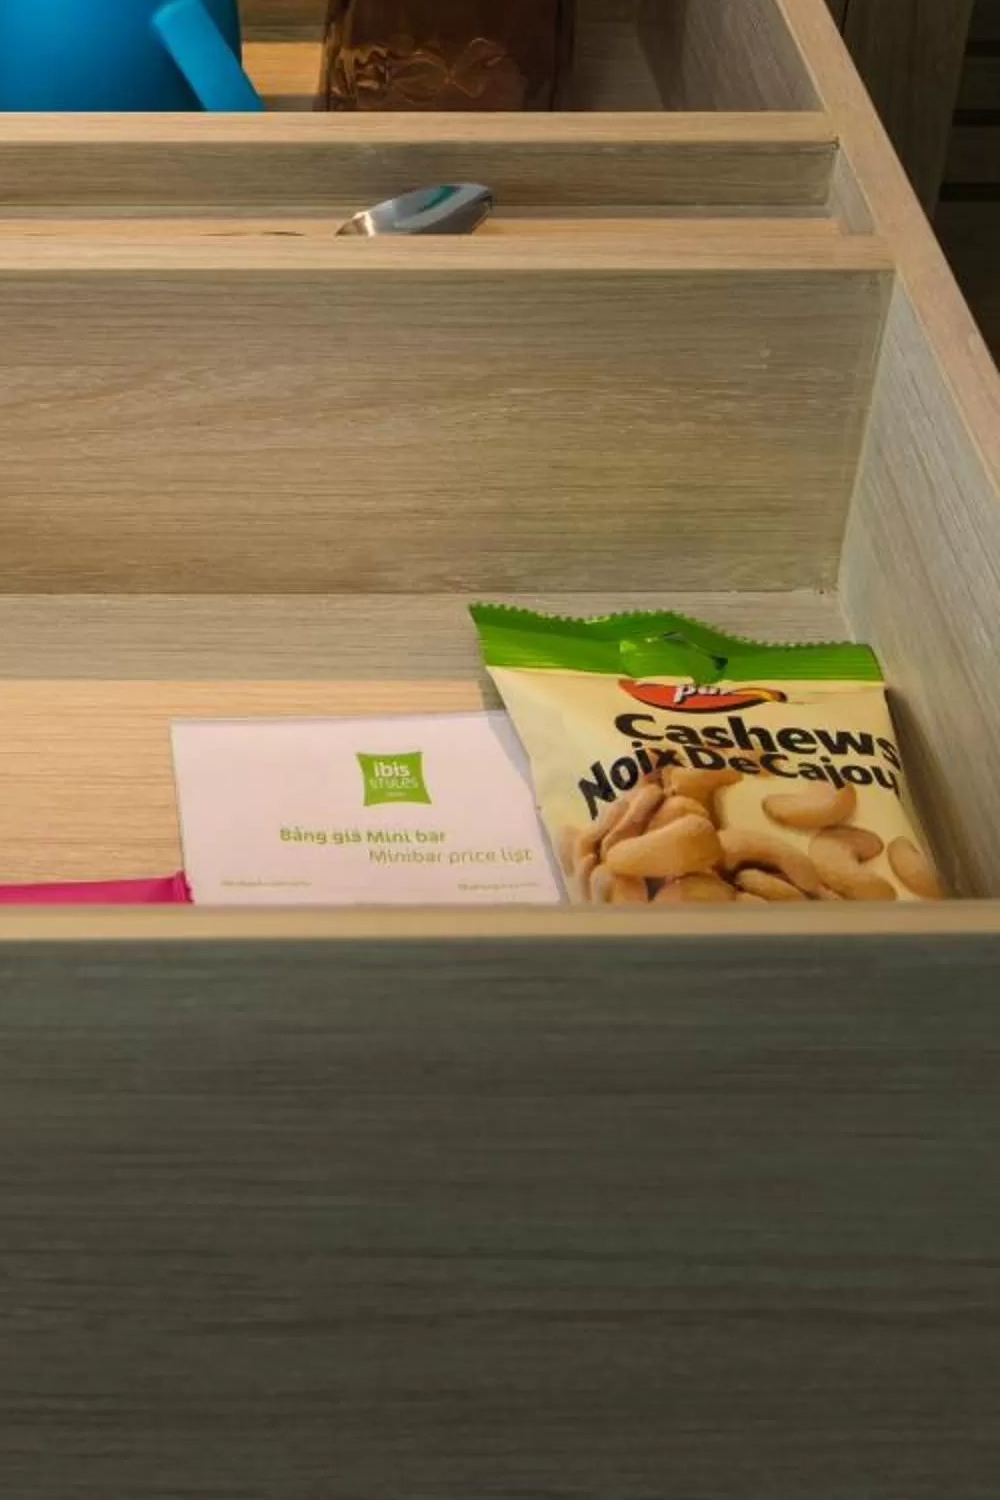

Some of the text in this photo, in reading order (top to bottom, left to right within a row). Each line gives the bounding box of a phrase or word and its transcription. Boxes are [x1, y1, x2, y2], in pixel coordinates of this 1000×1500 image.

[613, 713, 901, 771] Cashews
[373, 761, 411, 778] ibis
[366, 828, 411, 844] Mini
[415, 828, 447, 843] bar
[369, 847, 534, 866] Minibar price list
